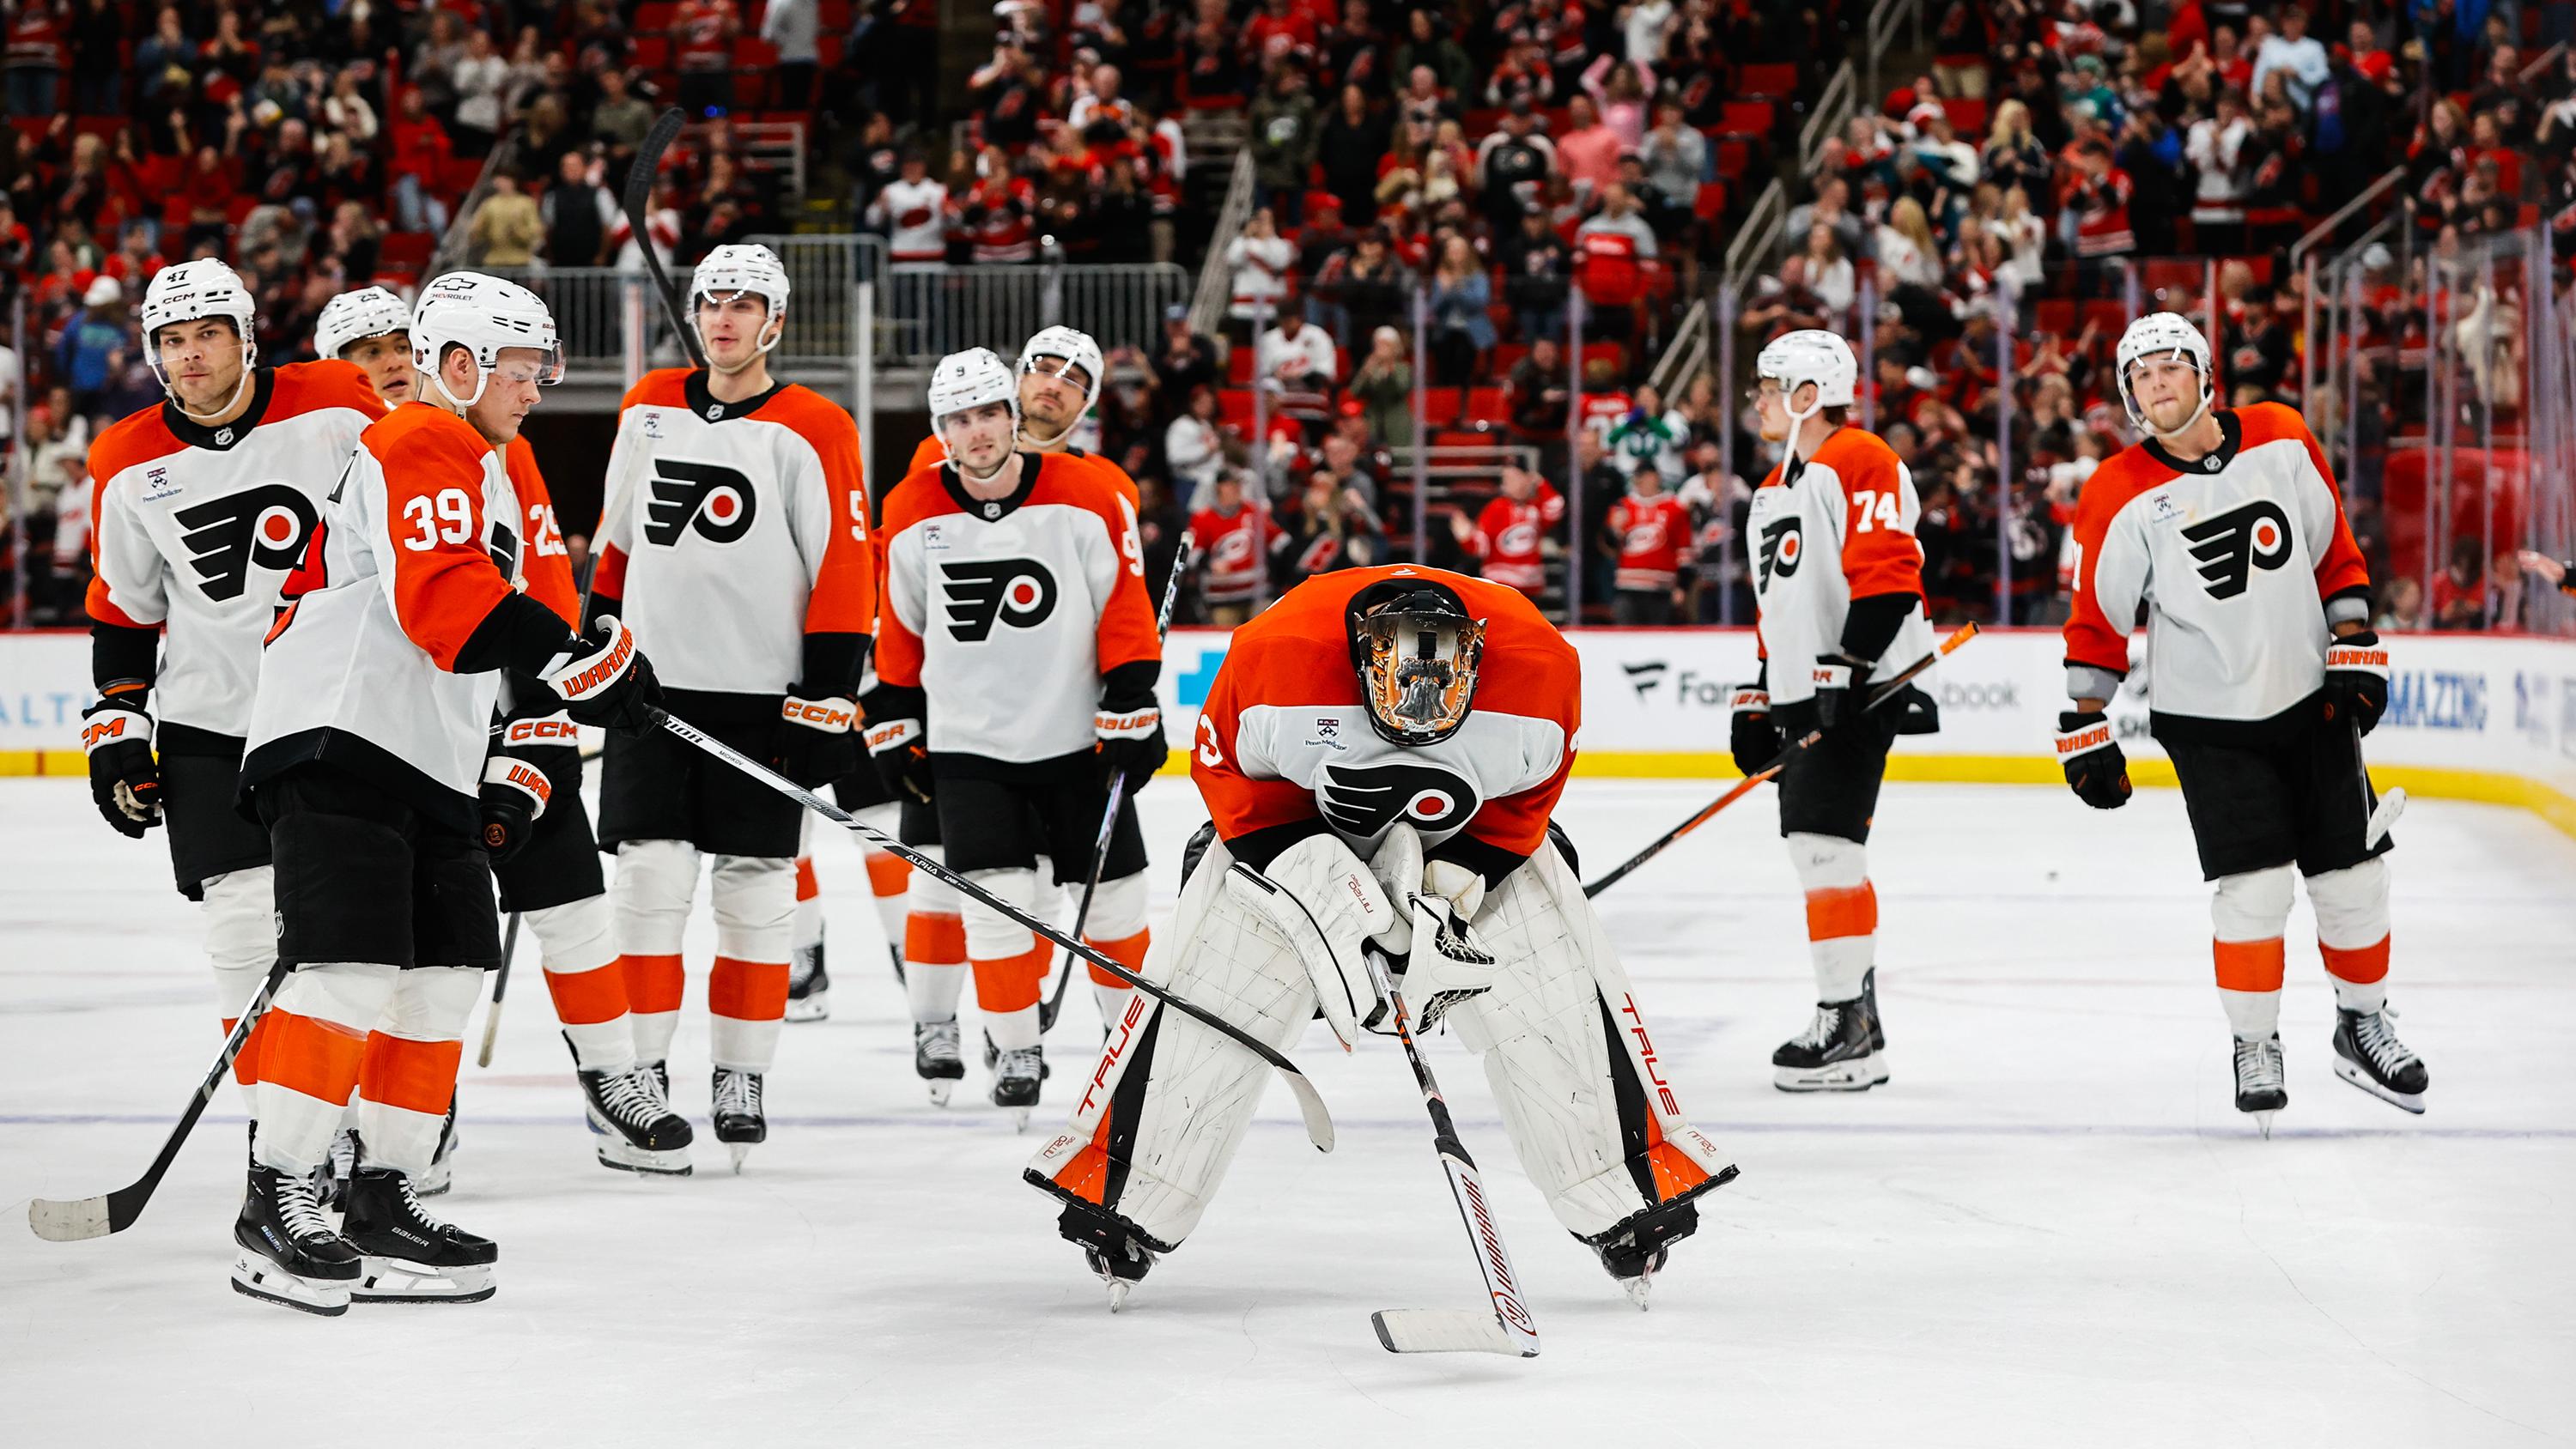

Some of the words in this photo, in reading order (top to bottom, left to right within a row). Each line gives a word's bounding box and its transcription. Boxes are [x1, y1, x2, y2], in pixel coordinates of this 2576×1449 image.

[167, 270, 189, 282] 47
[162, 293, 196, 305] CCM
[403, 488, 472, 551] 39
[849, 490, 866, 541] 5
[1853, 490, 1900, 533] 74
[510, 722, 577, 741] CCM
[782, 701, 850, 726] CCM
[1200, 714, 1224, 767] 3
[905, 854, 939, 875] ALPHA
[1078, 994, 1146, 1117] TRUE
[1621, 991, 1681, 1116] TRUE
[392, 1227, 430, 1247] BAUER
[1461, 1173, 1516, 1295] WARRIOR
